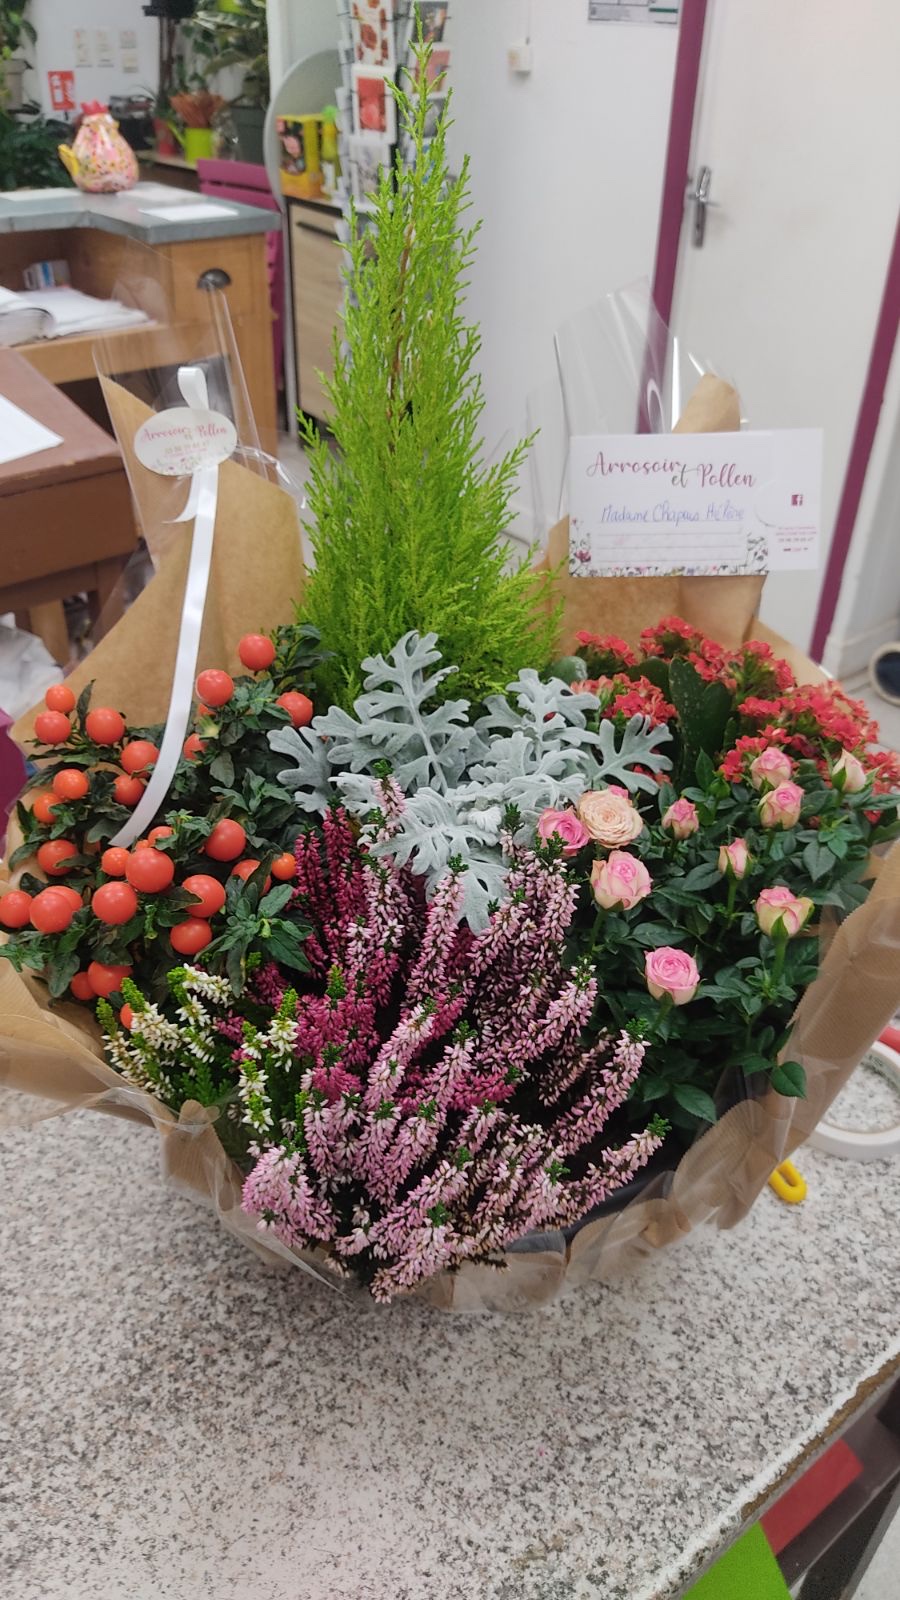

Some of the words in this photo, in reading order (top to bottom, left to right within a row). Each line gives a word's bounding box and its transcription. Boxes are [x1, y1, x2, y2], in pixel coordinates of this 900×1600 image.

[586, 451, 681, 477] Arrosoir
[671, 463, 698, 488] et
[697, 463, 754, 488] Pollen
[601, 503, 649, 523] Madame
